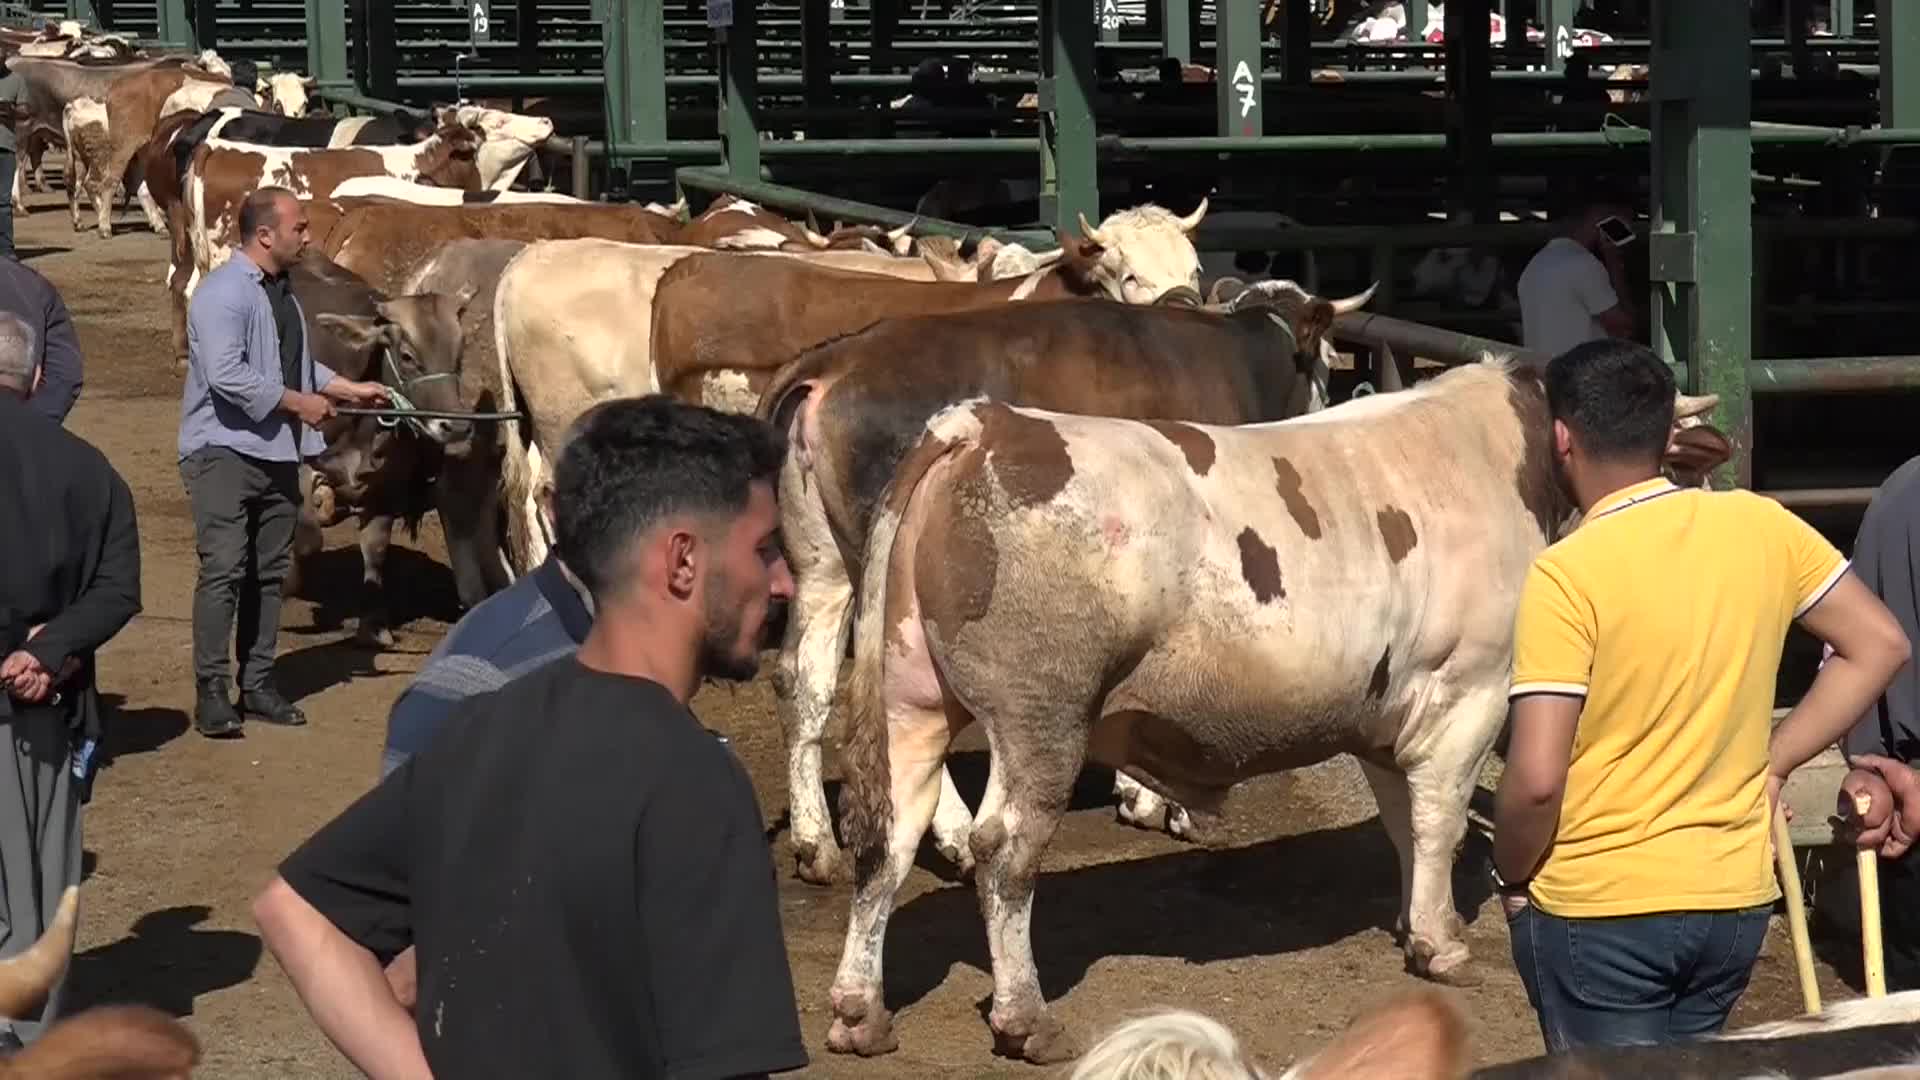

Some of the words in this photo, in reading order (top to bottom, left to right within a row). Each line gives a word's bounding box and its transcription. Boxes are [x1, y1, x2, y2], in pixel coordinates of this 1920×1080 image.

[474, 3, 484, 17] A
[475, 17, 488, 32] 19
[1102, 15, 1119, 29] 20
[1557, 25, 1569, 41] A
[1232, 61, 1254, 84] A
[1236, 83, 1256, 118] 7
